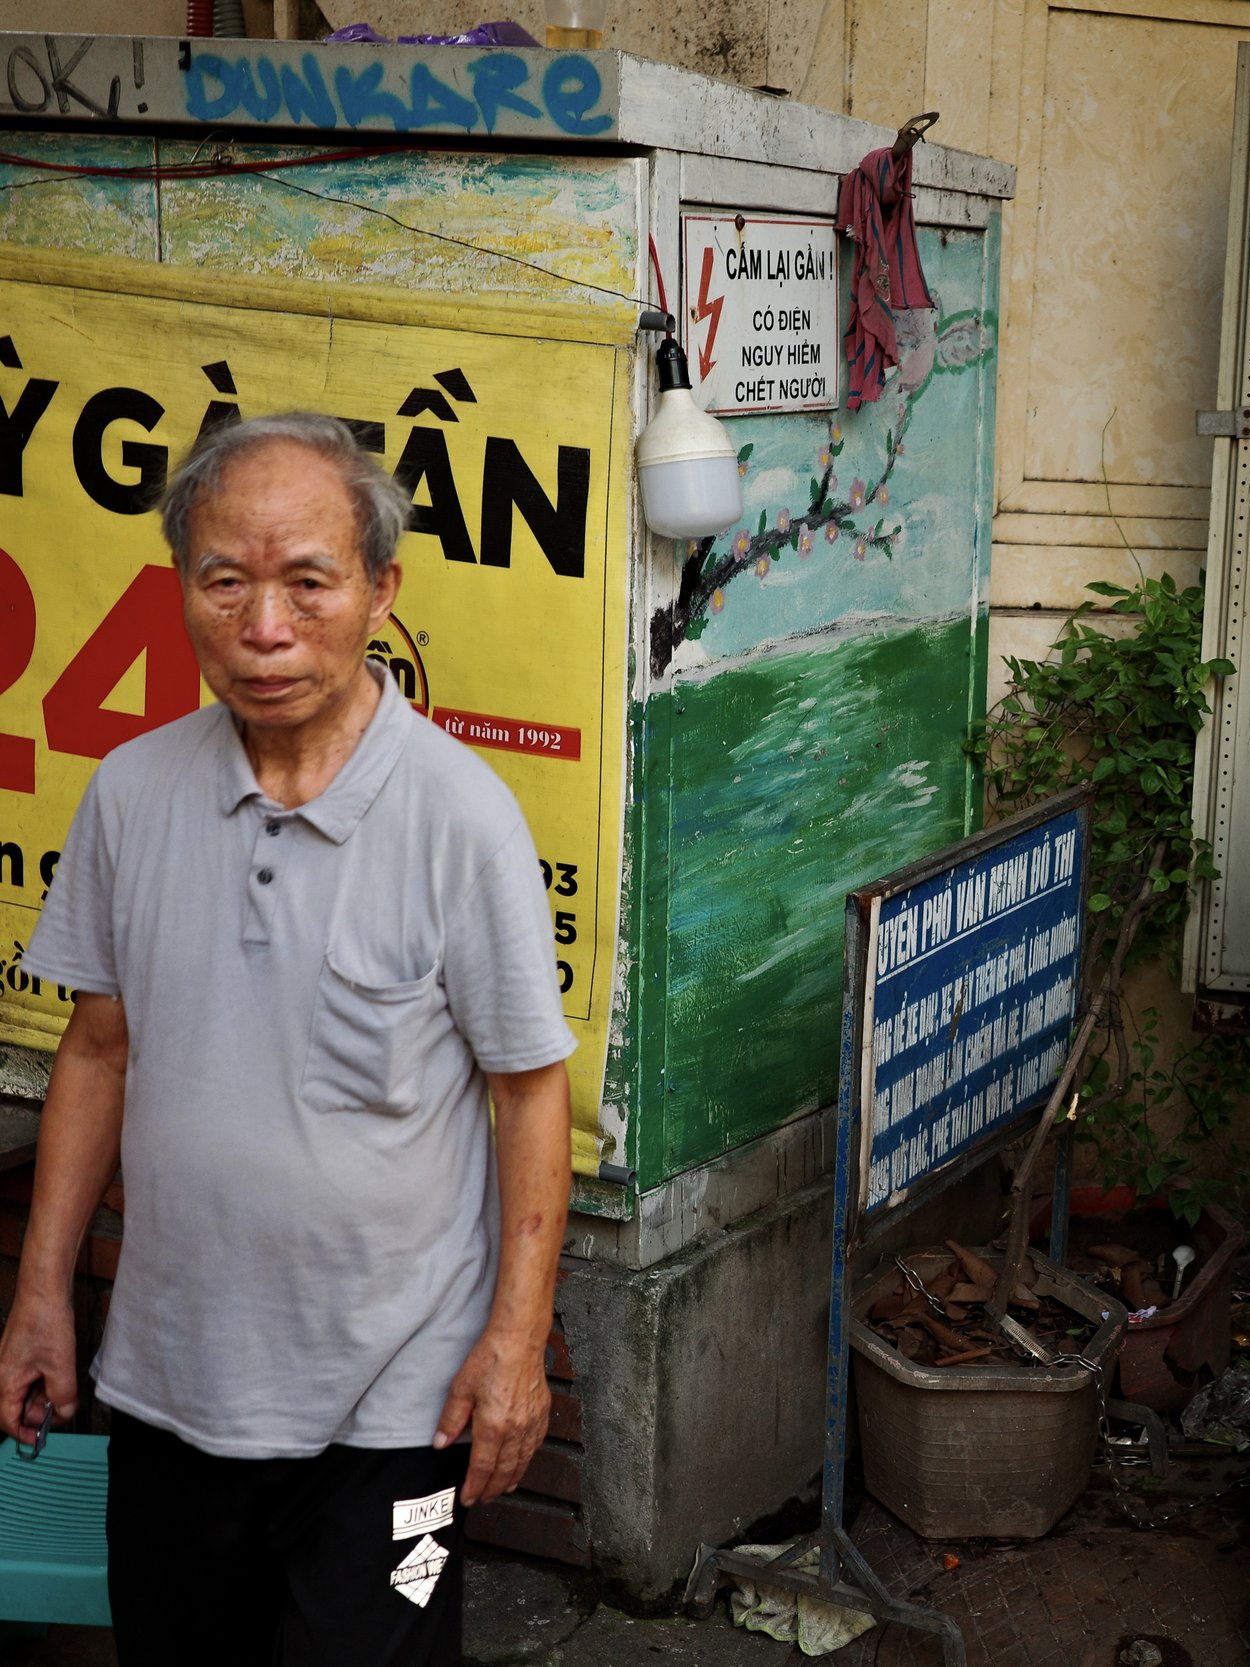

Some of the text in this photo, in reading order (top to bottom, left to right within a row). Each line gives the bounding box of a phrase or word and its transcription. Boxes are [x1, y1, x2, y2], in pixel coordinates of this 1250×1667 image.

[726, 242, 762, 280] CẤM
[767, 250, 790, 288] LẠI
[794, 243, 825, 281] GẦN
[753, 305, 811, 336] CÓ ĐIỆN
[742, 339, 821, 367] NGUY HIỂM
[735, 372, 826, 402] CHẾT NGƯỜI
[445, 716, 562, 750] từ năm 1992
[877, 829, 1076, 976] UYẾN PHỐ VĂN MINH ĐÔ THỊ
[404, 1496, 449, 1524] JINKE
